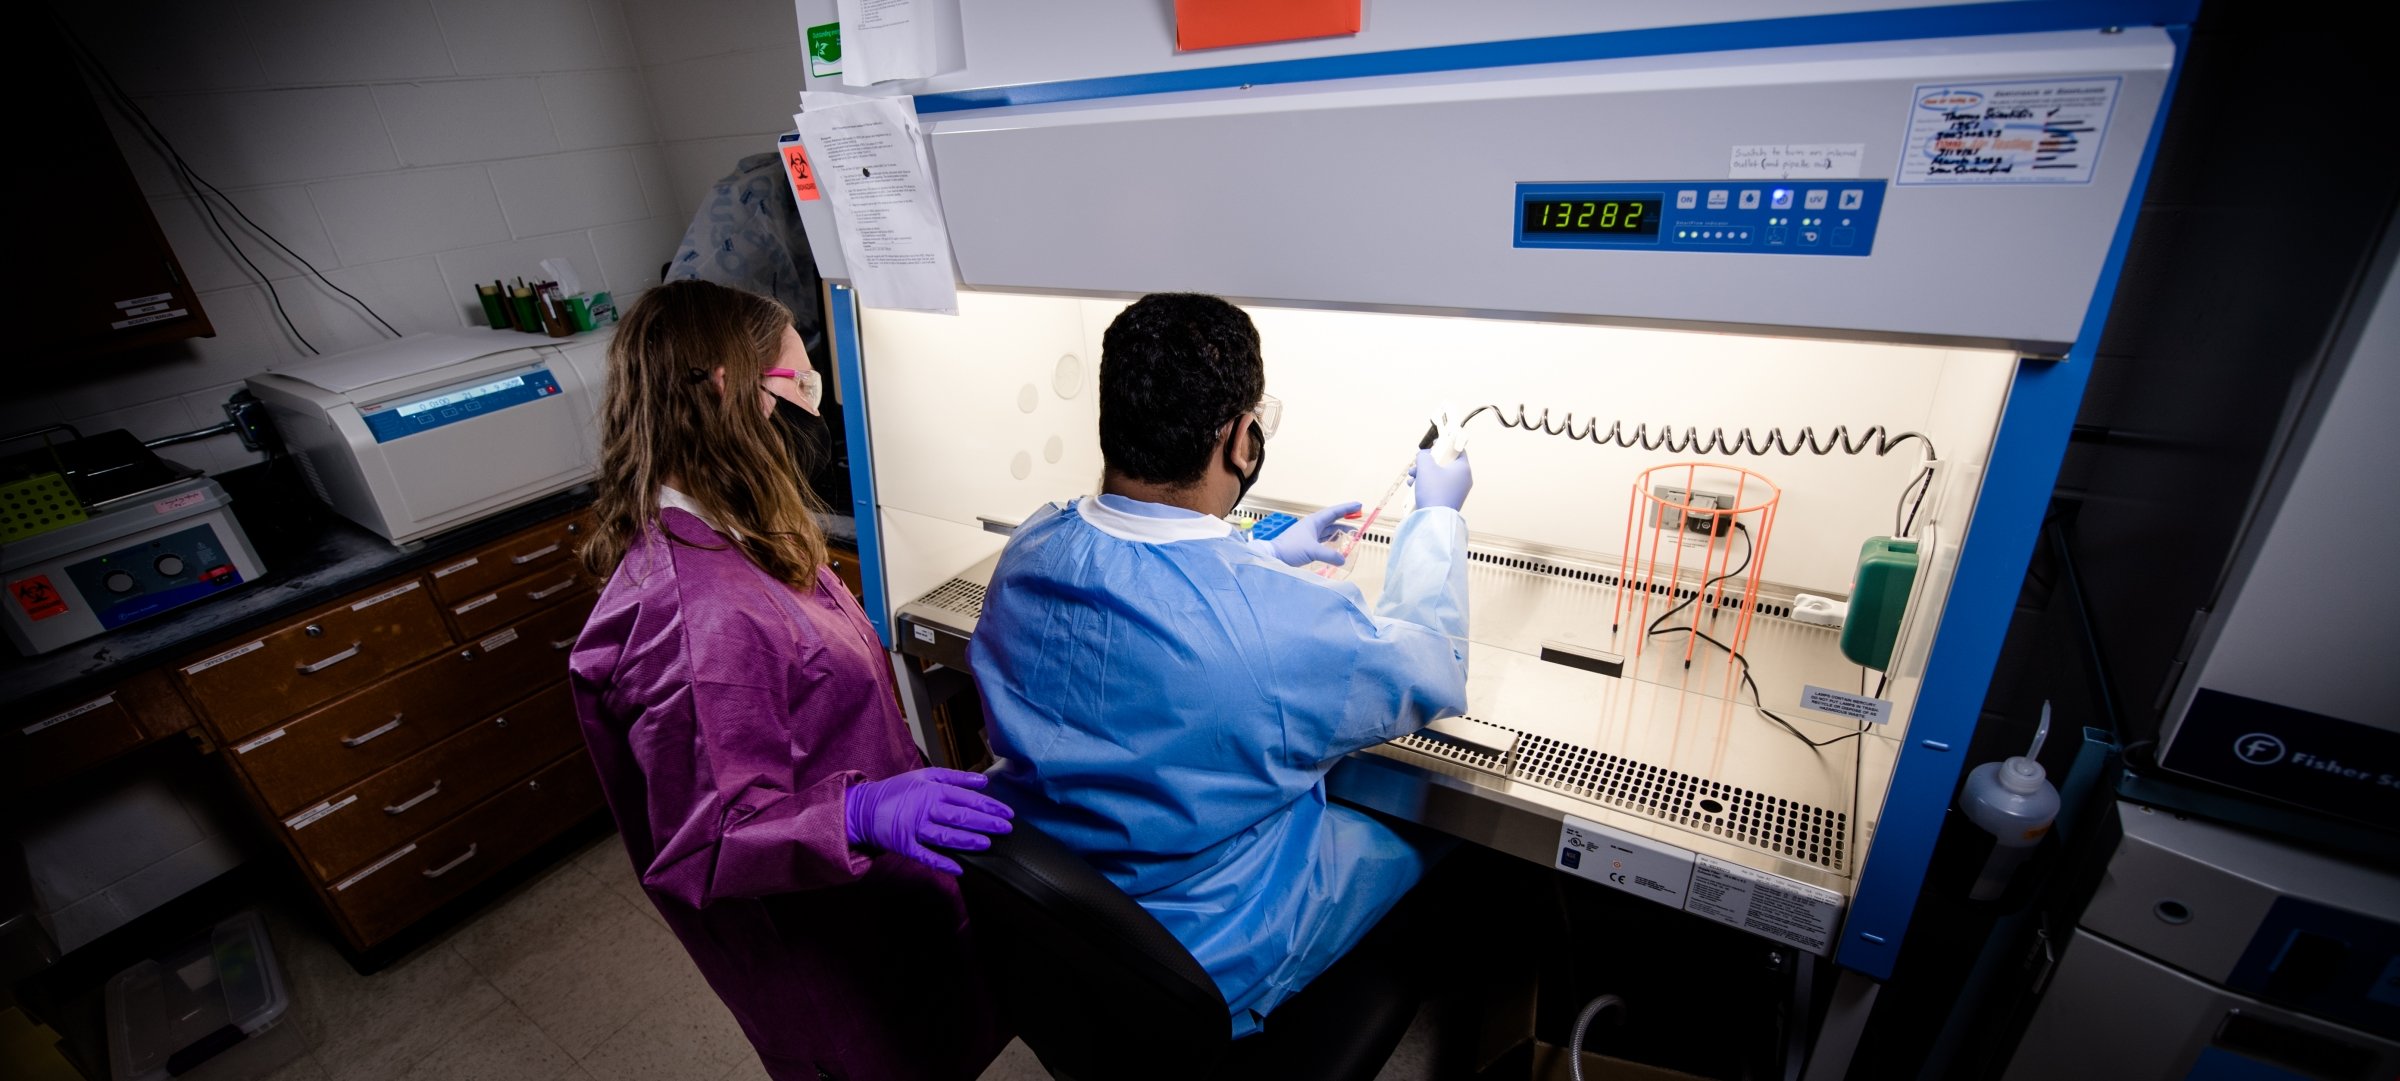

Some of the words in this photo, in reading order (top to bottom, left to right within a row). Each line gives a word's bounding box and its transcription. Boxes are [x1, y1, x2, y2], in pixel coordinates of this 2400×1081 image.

[1681, 196, 1693, 205] ON
[1810, 195, 1823, 205] UV
[1542, 203, 1643, 229] 13282
[2291, 752, 2371, 780] Fisher
